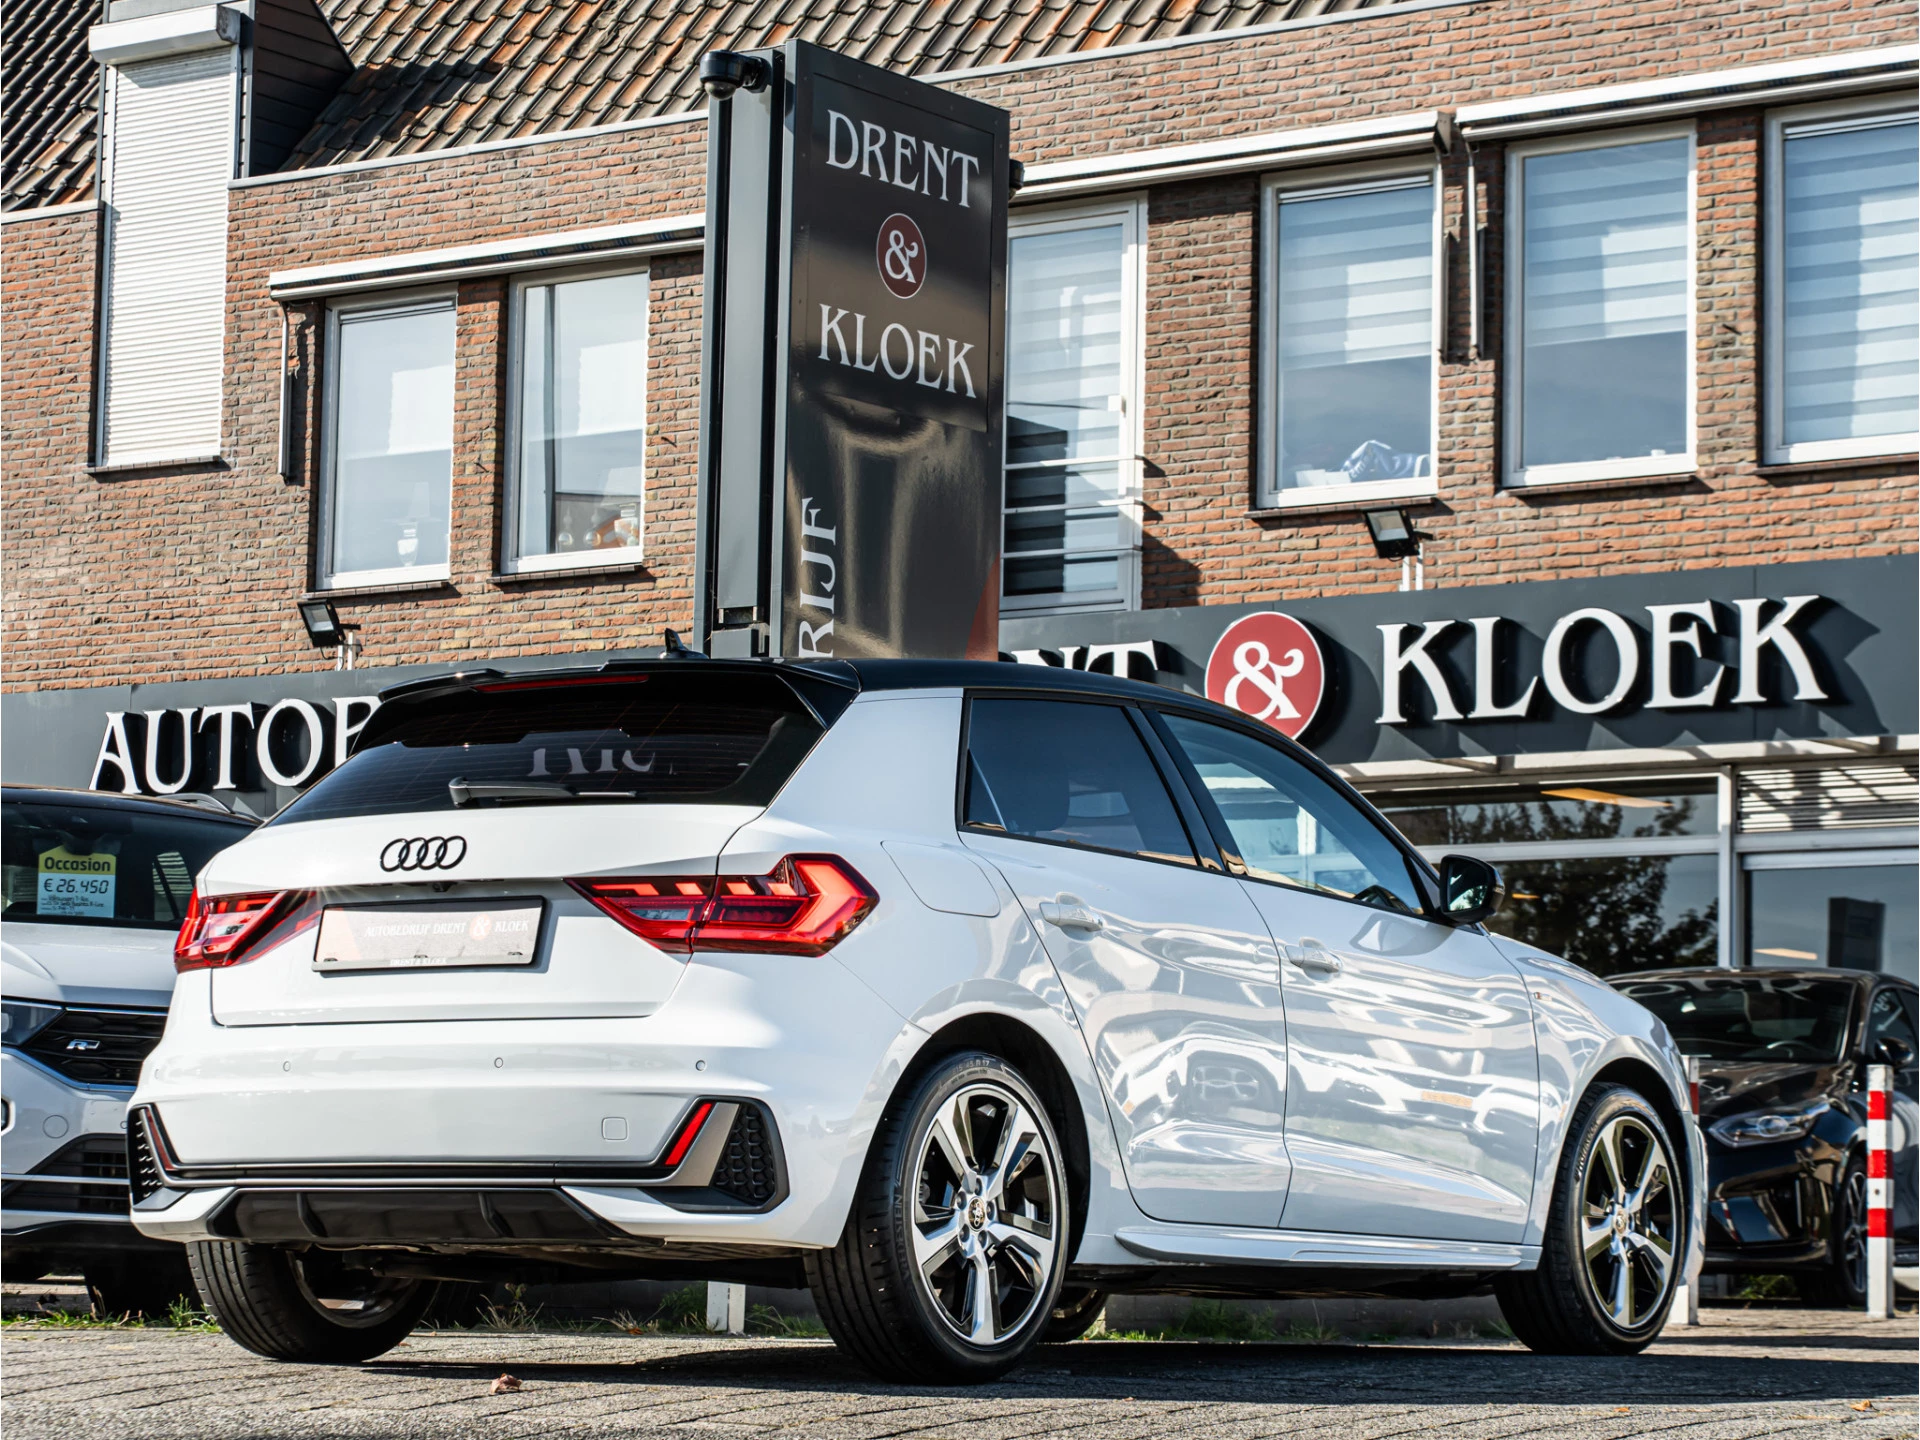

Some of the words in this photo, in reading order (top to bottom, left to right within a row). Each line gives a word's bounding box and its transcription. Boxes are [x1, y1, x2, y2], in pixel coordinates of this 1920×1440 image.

[826, 109, 980, 208] DRENT
[884, 229, 919, 284] &
[817, 303, 977, 399] KLOEK
[1224, 640, 1305, 720] &
[1375, 595, 1829, 724] KLOEK
[44, 856, 111, 872] Occasion
[432, 922, 466, 934] DRENT
[494, 920, 529, 932] KLOEK
